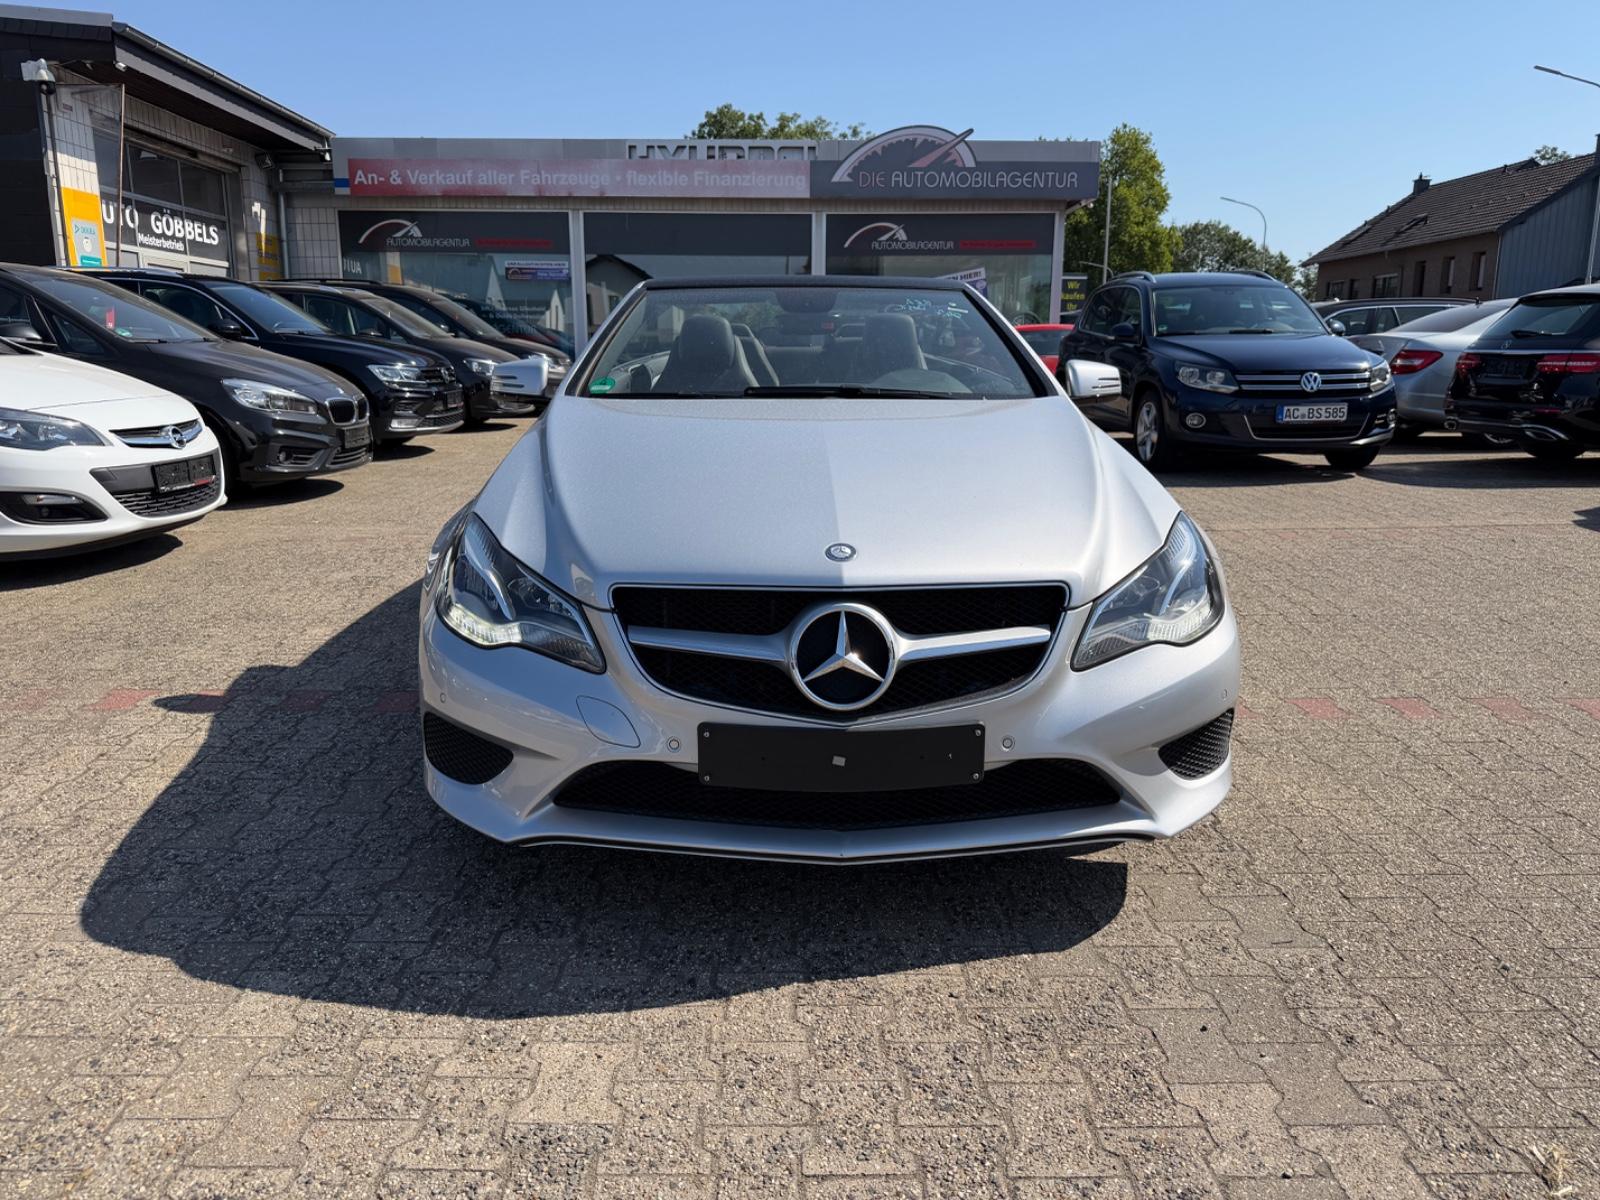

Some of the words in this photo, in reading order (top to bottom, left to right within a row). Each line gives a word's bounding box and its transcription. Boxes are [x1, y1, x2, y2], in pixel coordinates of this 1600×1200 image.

[354, 169, 385, 185] An-
[389, 169, 402, 185] &
[407, 169, 473, 185] Verkauf
[478, 170, 515, 186] aller
[520, 170, 610, 189] Fahrzeuge
[627, 171, 688, 187] flexible
[694, 171, 806, 190] Finanzierung
[859, 172, 886, 188] DIE
[891, 171, 1078, 188] AUTOMOBILAGENTUR
[151, 209, 219, 245] GÖBBELS
[138, 232, 185, 252] Meisterbetrieb
[872, 241, 954, 250] AUTOMOBILAGENTUR
[1284, 407, 1300, 420] AC
